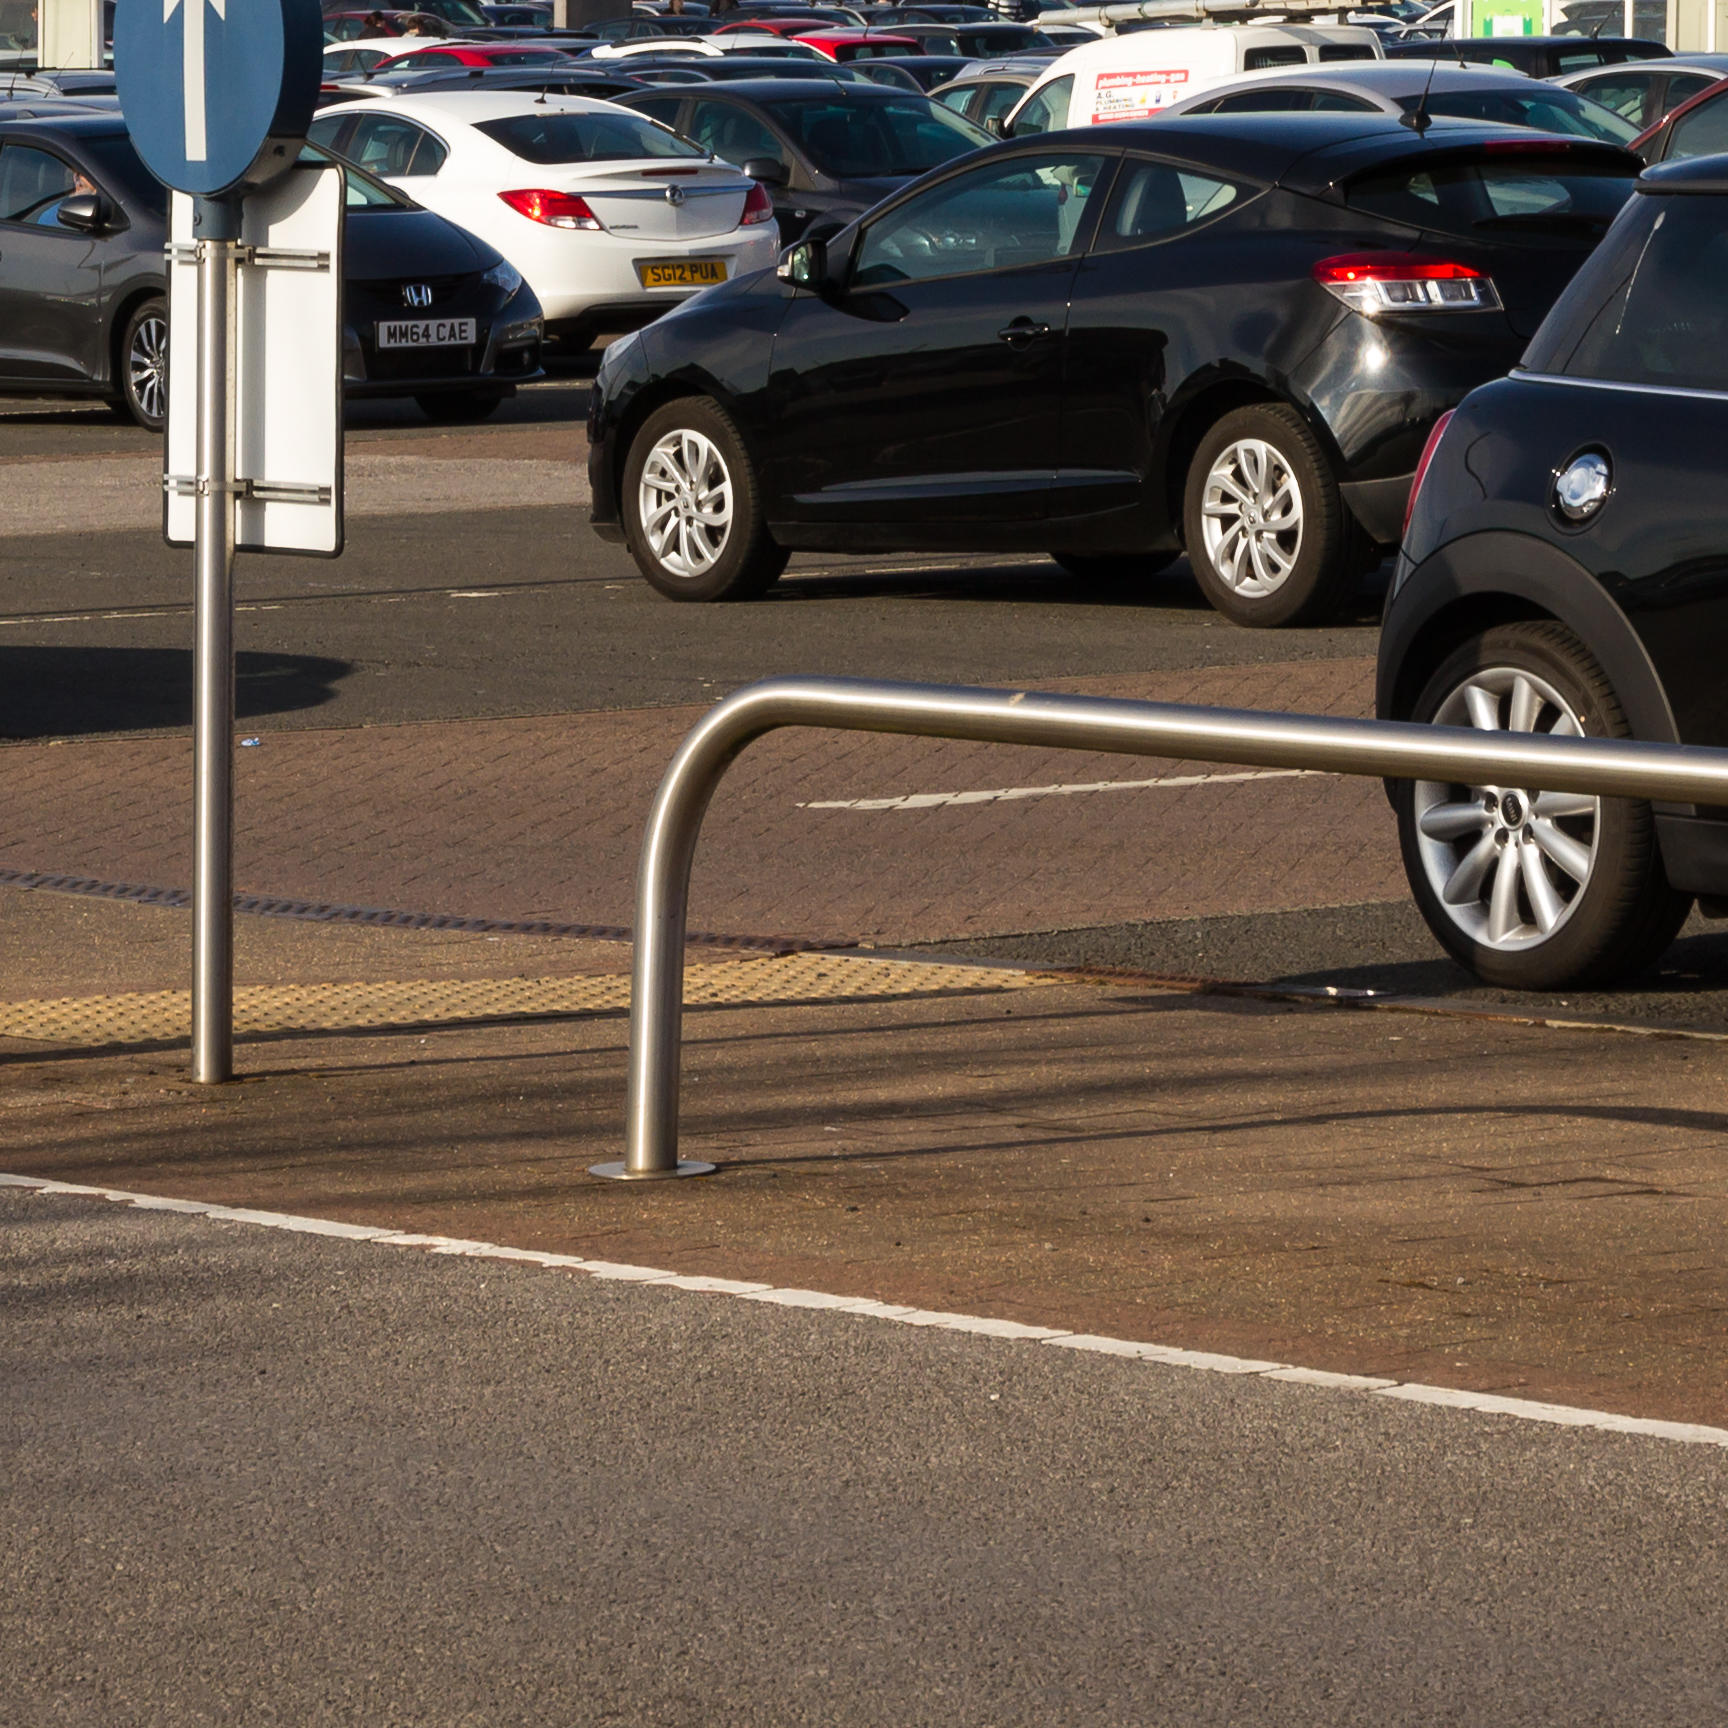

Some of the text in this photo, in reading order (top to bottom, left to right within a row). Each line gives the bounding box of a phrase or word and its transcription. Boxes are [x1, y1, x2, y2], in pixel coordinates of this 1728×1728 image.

[651, 263, 687, 283] SG12
[387, 321, 469, 345] MM64 CAE
